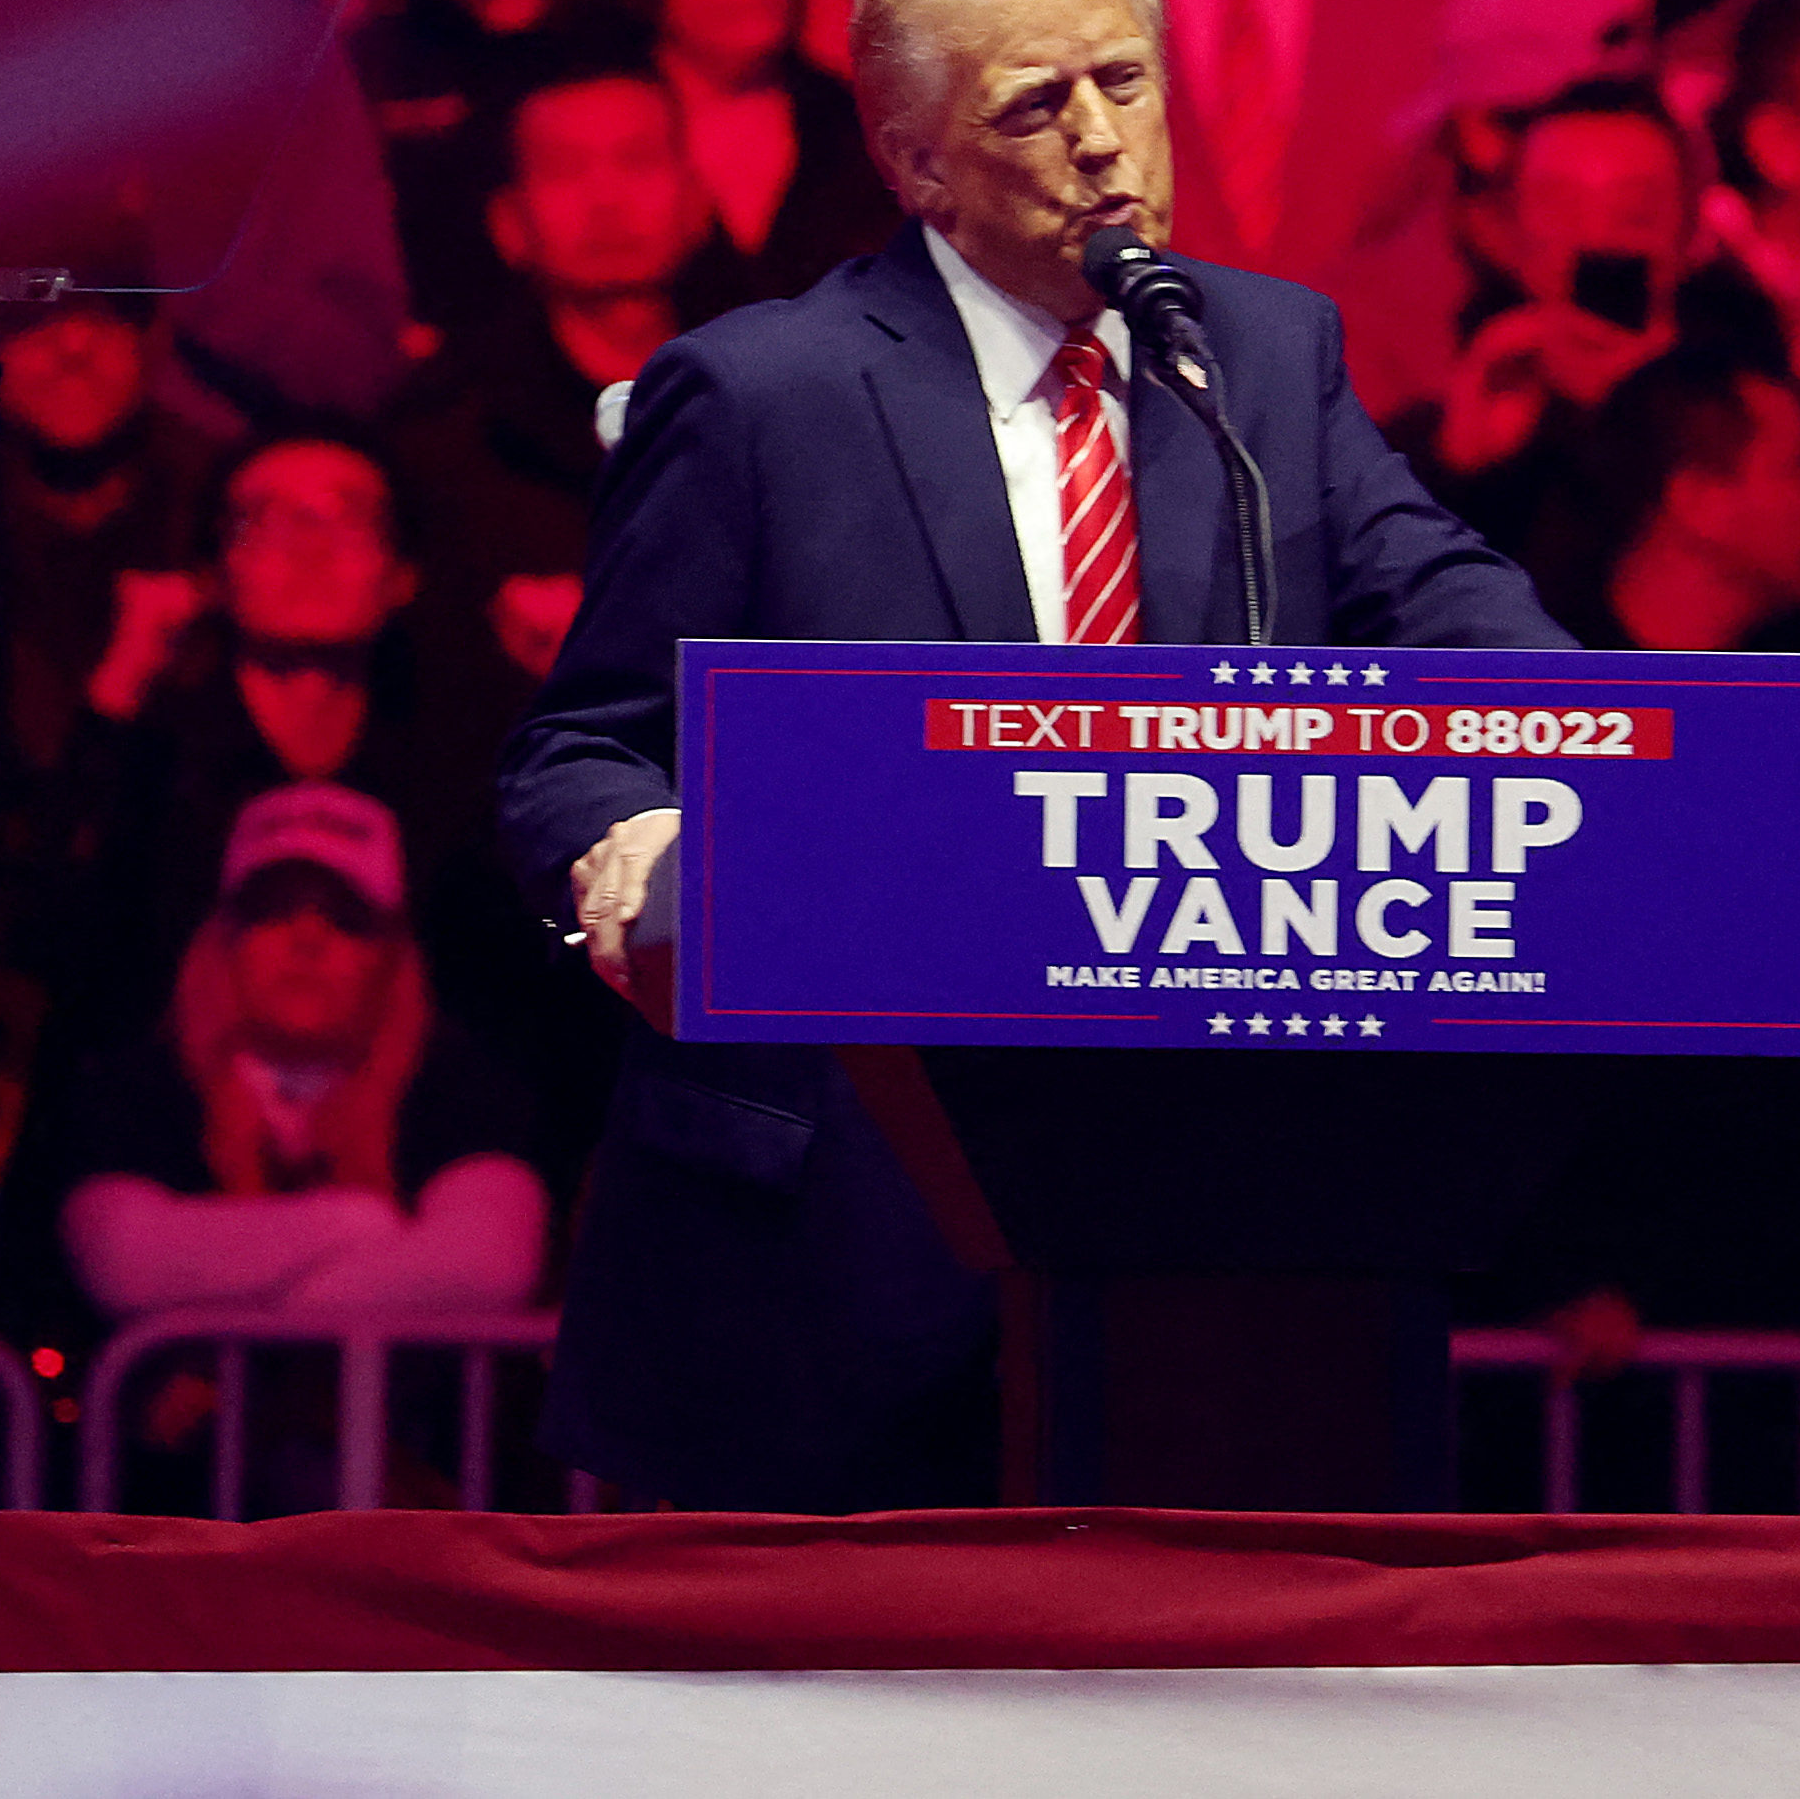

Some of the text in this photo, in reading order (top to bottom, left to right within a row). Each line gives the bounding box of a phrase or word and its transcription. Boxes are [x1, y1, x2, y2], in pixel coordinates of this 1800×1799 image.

[950, 704, 1634, 756] TEXT TRUMP TO 88022
[1014, 771, 1582, 873] TRUMP
[1076, 876, 1516, 959] VANCE
[1046, 966, 1546, 993] MAKE AMERICA GREAT AGAIN!
